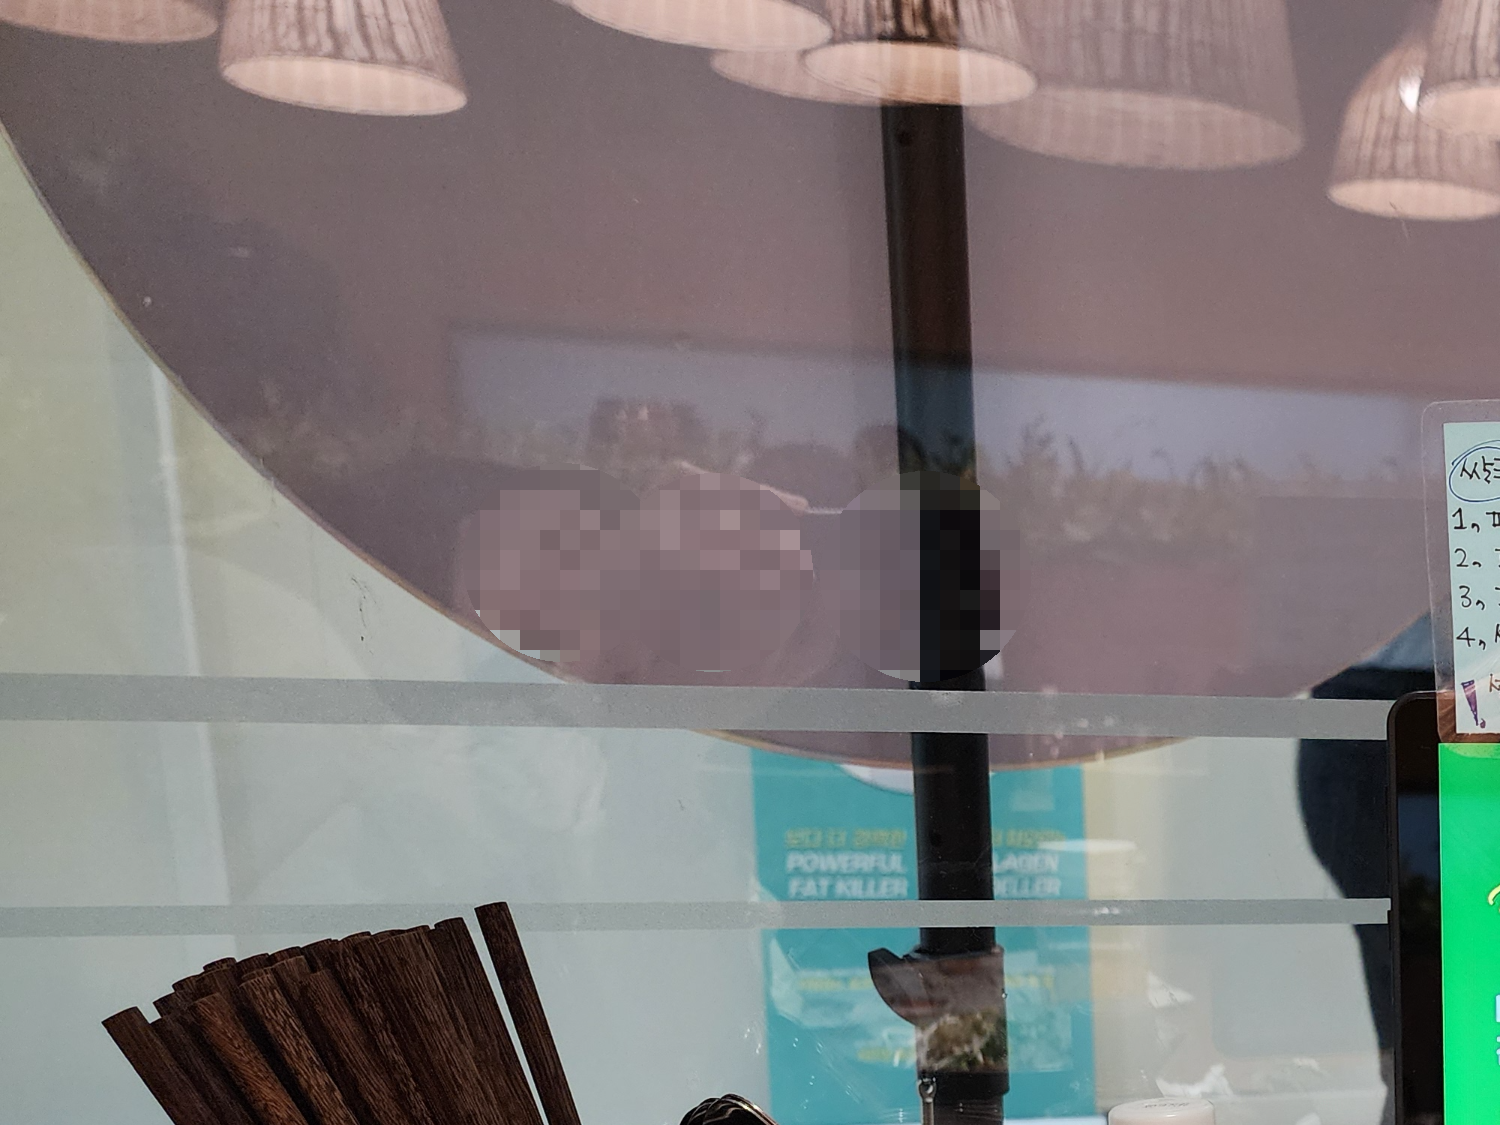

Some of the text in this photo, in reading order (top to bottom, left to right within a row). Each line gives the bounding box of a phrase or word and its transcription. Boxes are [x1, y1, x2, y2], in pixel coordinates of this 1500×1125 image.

[786, 851, 906, 874] POWERFUL
[788, 875, 909, 898] FAT KILLER
